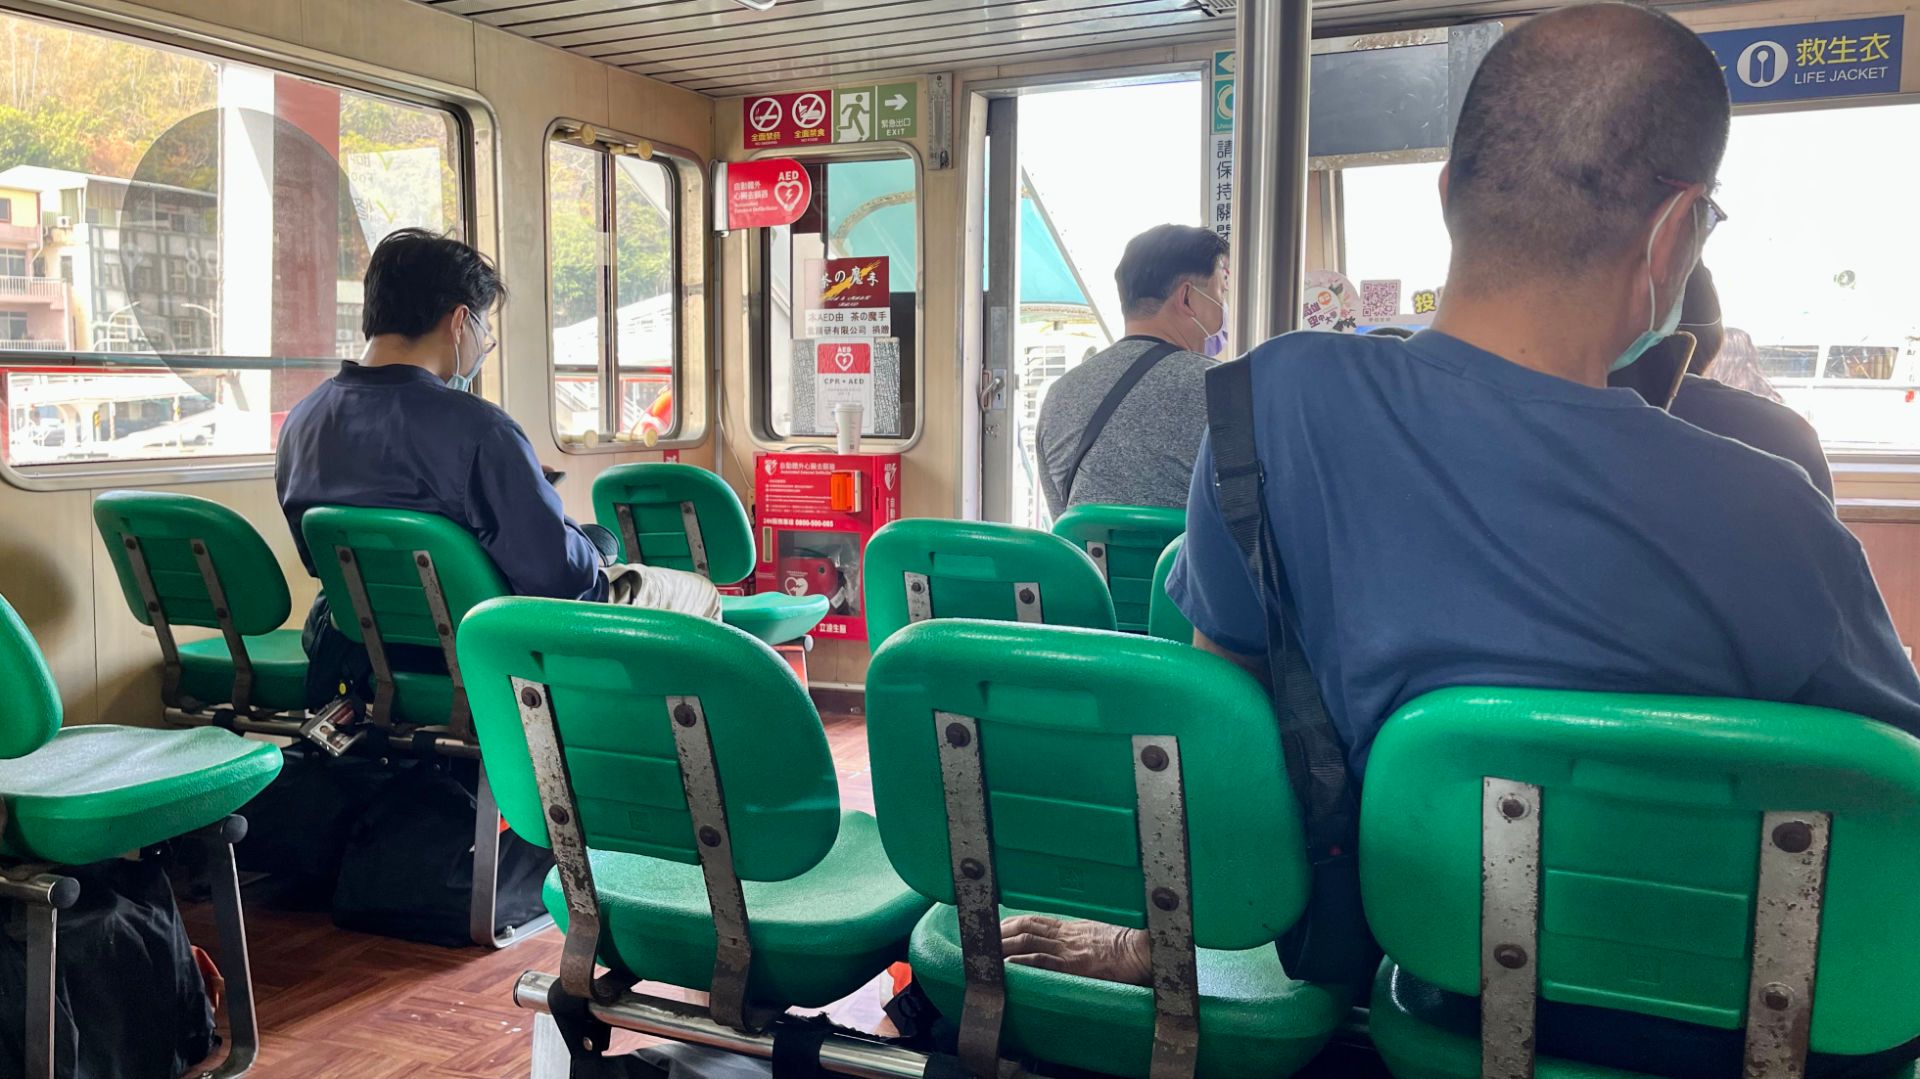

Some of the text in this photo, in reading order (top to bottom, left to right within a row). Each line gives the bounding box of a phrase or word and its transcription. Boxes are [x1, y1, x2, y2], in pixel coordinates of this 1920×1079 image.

[1795, 32, 1892, 67] 救生衣
[1794, 66, 1888, 84] LIFE JACKET
[886, 128, 905, 136] EXIT
[778, 170, 799, 181] AED
[1413, 290, 1437, 314] 投
[808, 311, 887, 322] 本AED由 茶の魔手
